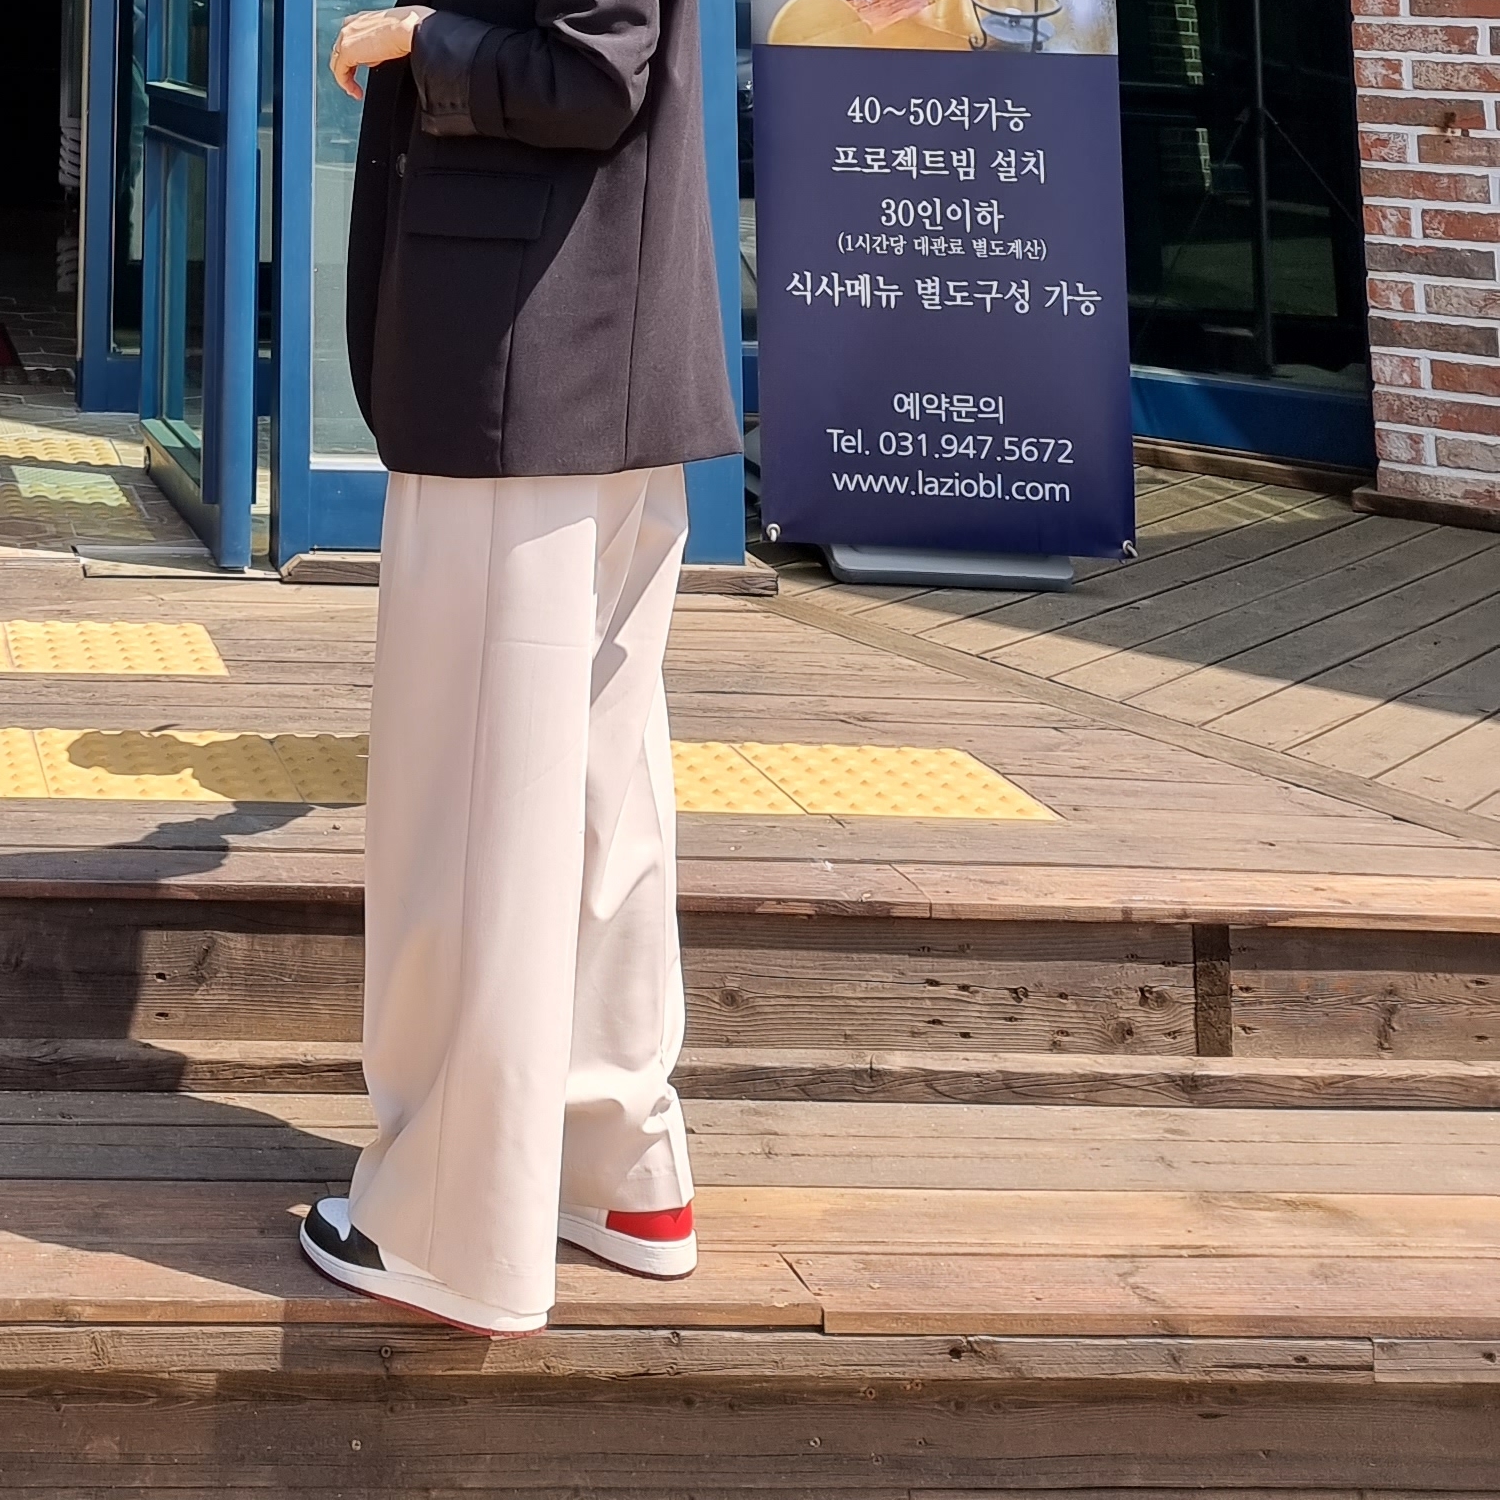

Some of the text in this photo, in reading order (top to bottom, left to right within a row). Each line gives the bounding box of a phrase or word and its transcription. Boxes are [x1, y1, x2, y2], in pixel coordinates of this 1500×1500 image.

[847, 96, 1031, 132] 40~50석가능
[831, 146, 1046, 184] 프로젝트빔 설치
[880, 198, 1005, 235] 30인이하
[838, 232, 1048, 261] (1시간당 대관료 별도계산)
[786, 271, 1102, 317] 식사메뉴 별도구성 가능
[893, 392, 1005, 424] 예약문의
[826, 429, 1074, 464] Tel. 031.947.5672
[831, 469, 1071, 502] www.laziobl.com
